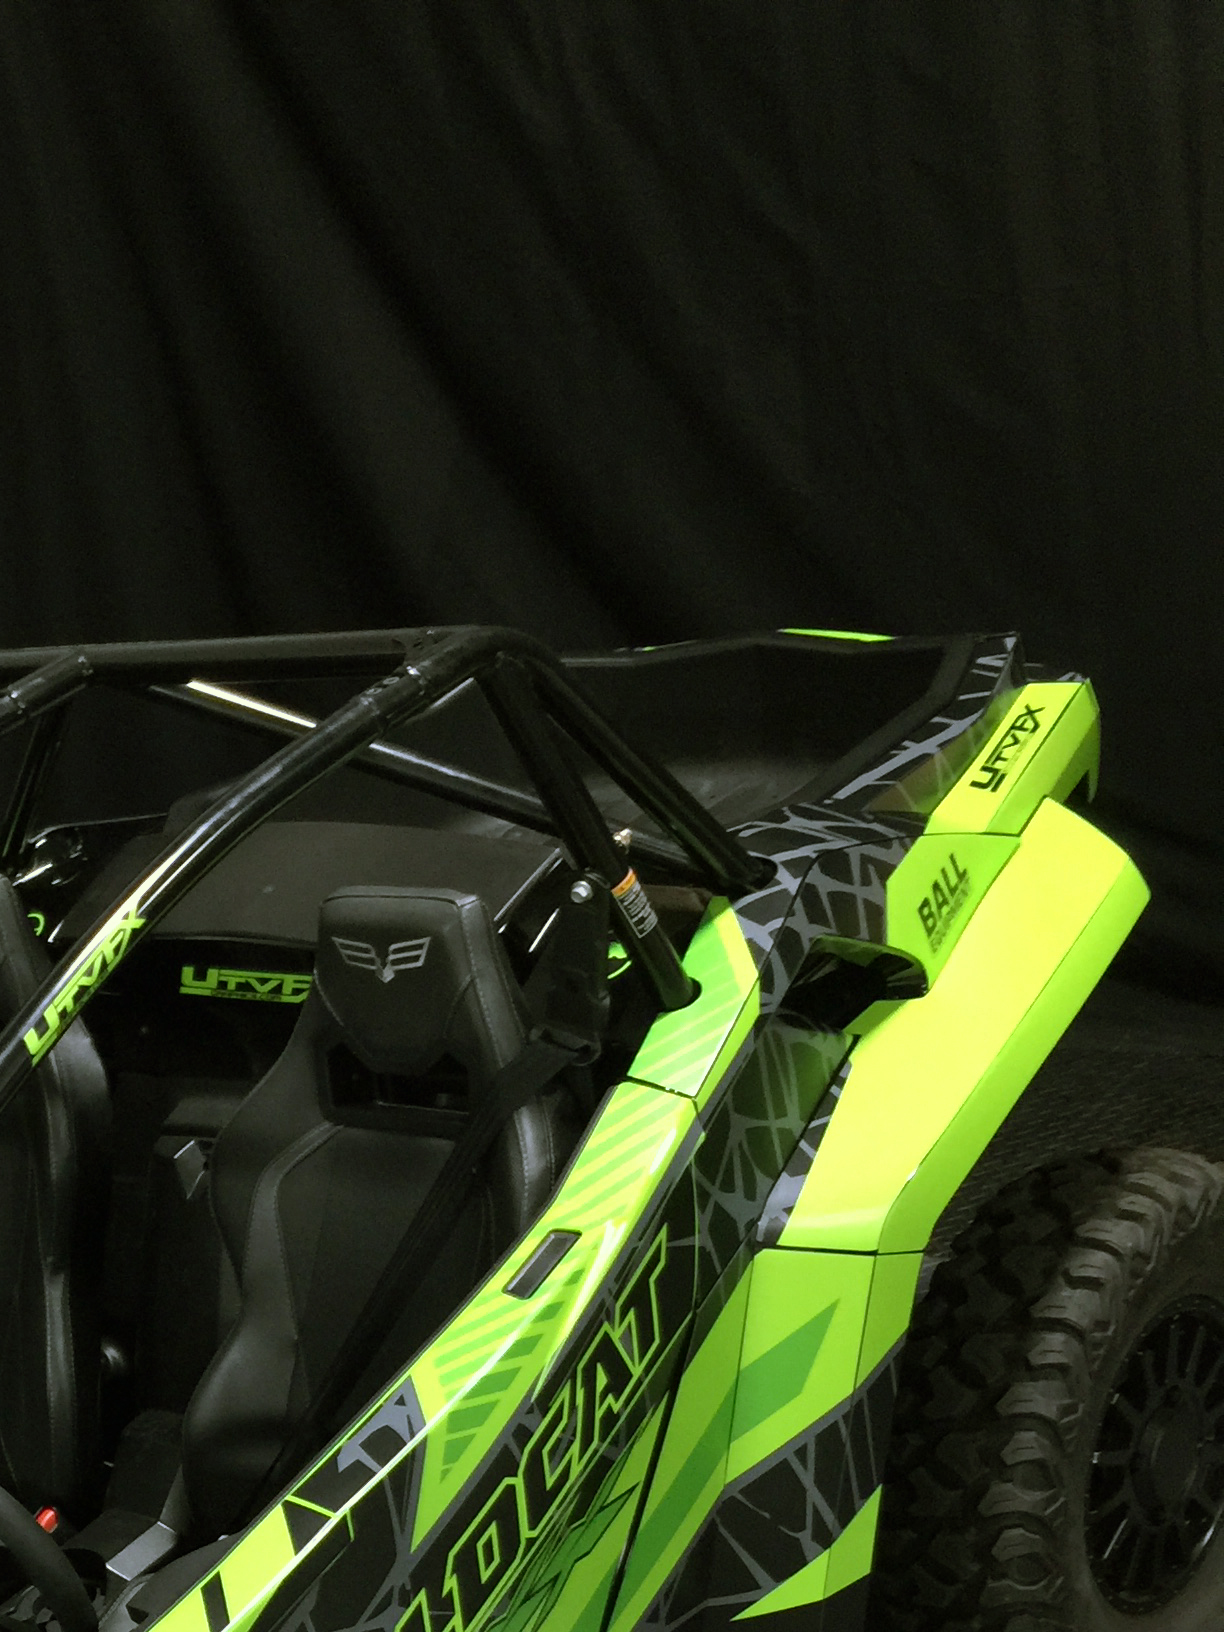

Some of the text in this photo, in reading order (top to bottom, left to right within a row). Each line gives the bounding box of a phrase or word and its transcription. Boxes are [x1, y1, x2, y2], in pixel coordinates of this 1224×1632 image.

[969, 703, 1046, 793] UTVFX
[918, 853, 968, 939] BALL
[23, 907, 147, 1068] UTVFX
[179, 966, 313, 1003] UTVF
